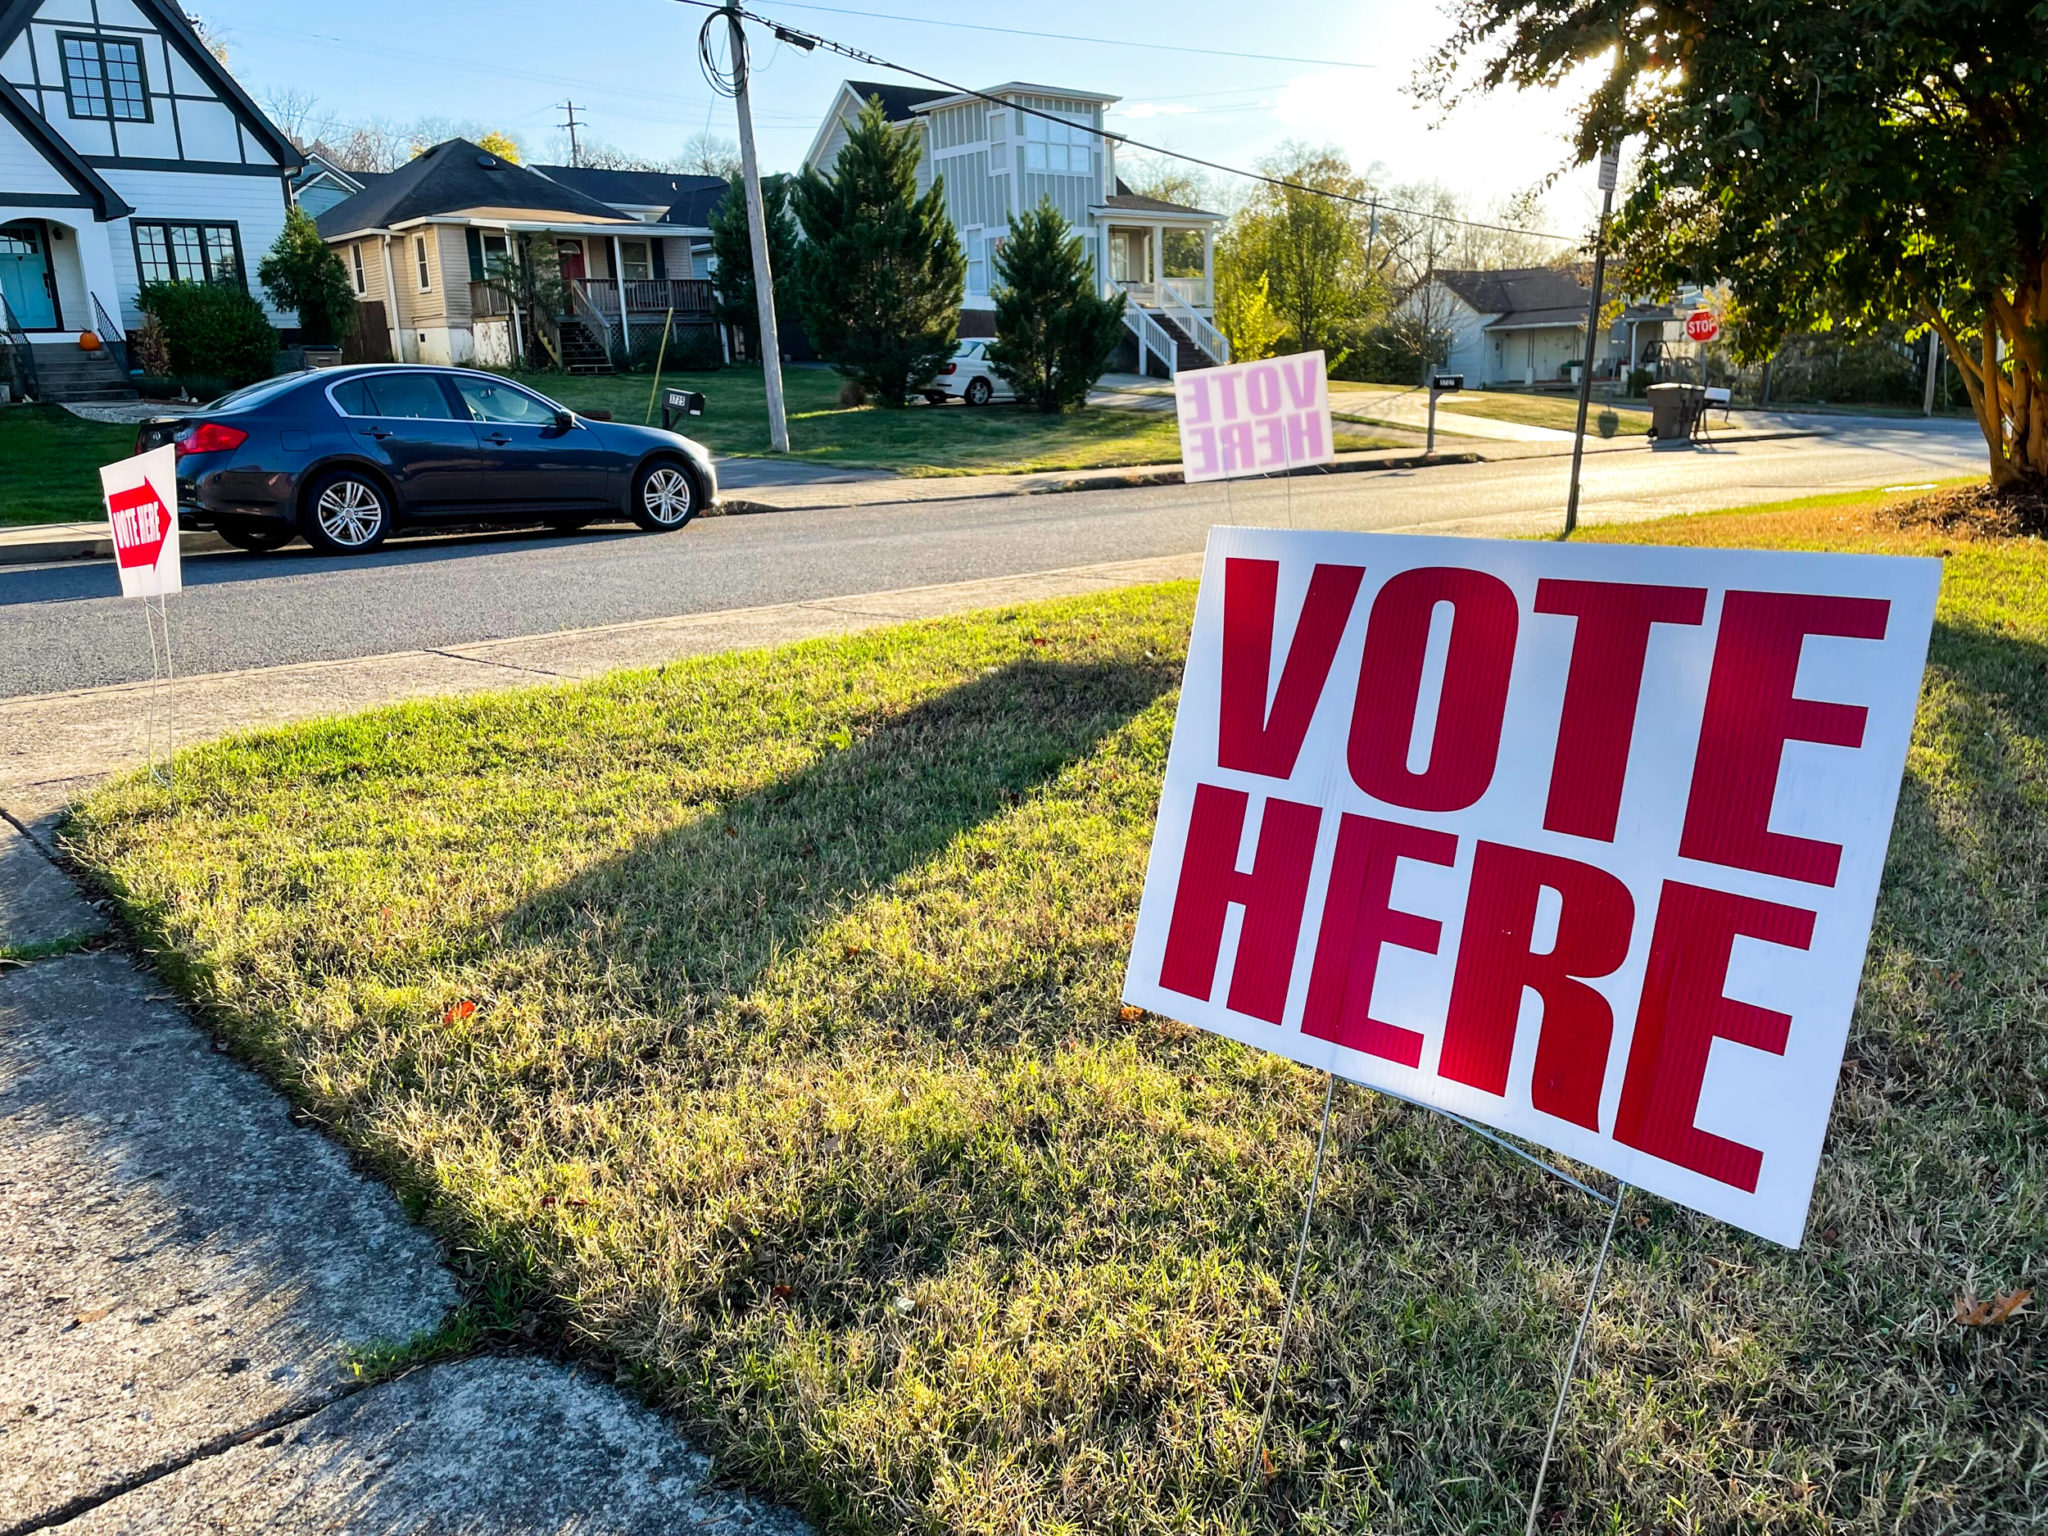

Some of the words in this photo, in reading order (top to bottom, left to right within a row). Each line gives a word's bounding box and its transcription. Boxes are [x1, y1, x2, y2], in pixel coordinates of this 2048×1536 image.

[112, 507, 140, 549] VOTE
[136, 501, 161, 545] HERE
[1218, 557, 1891, 888] VOTE
[1159, 782, 1818, 1195] HERE
